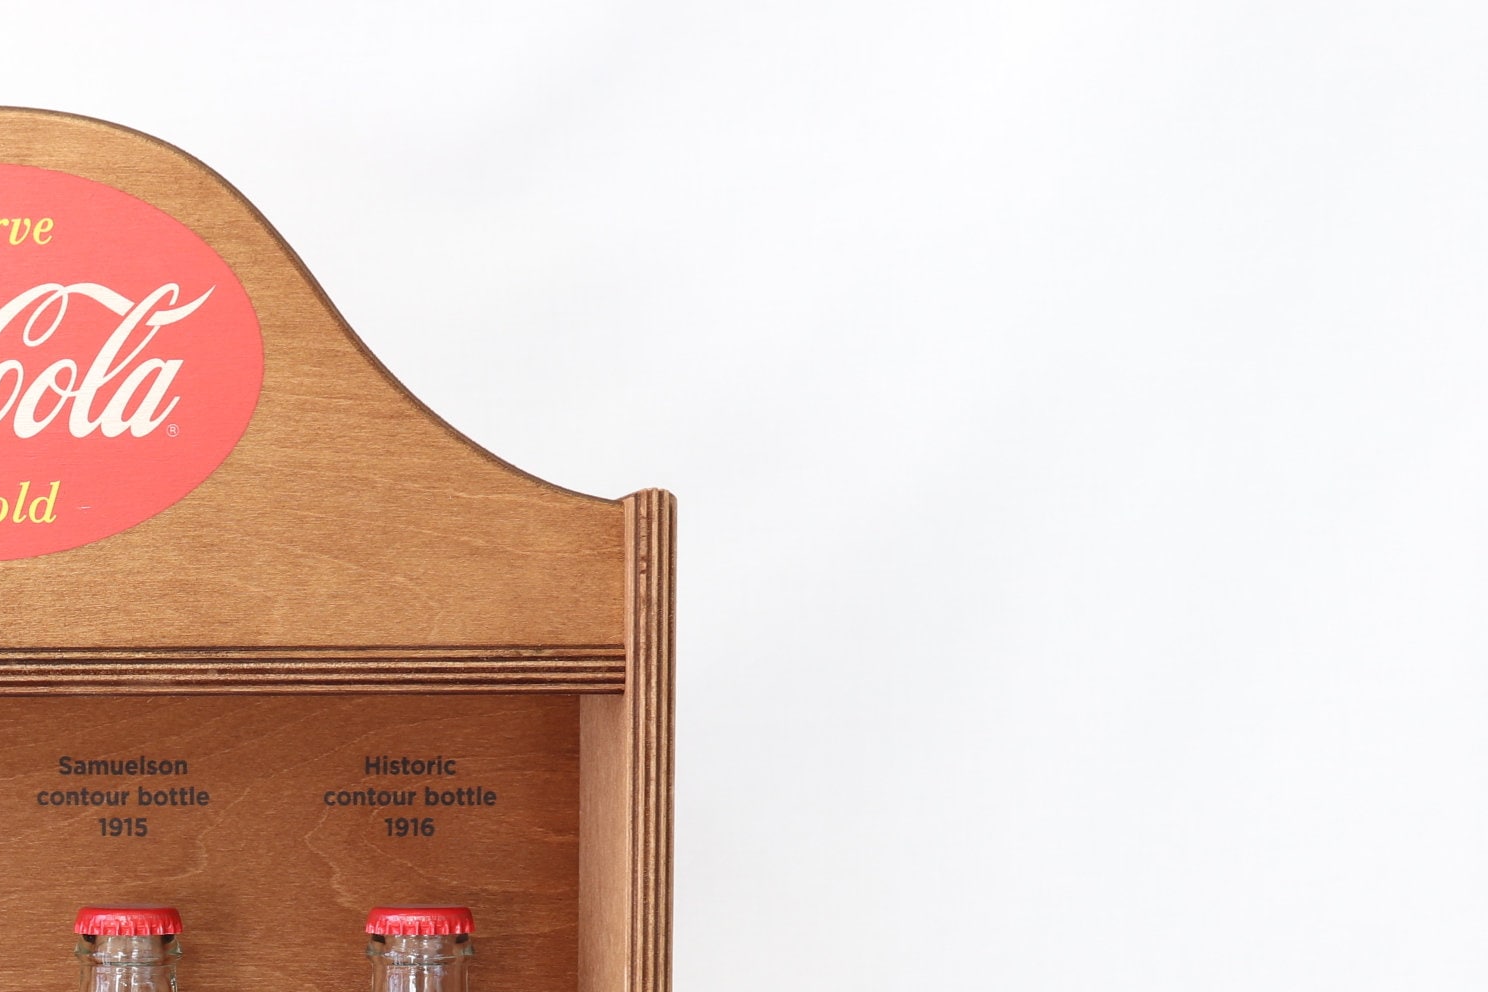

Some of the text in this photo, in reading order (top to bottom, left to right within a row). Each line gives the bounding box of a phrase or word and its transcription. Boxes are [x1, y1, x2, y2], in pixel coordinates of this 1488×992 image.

[58, 755, 189, 776] Samuelson
[365, 756, 457, 776] Historic
[36, 786, 210, 806] contour bottle
[323, 786, 497, 806] contour bottle
[98, 817, 149, 837] 1915
[384, 817, 435, 837] 1916
